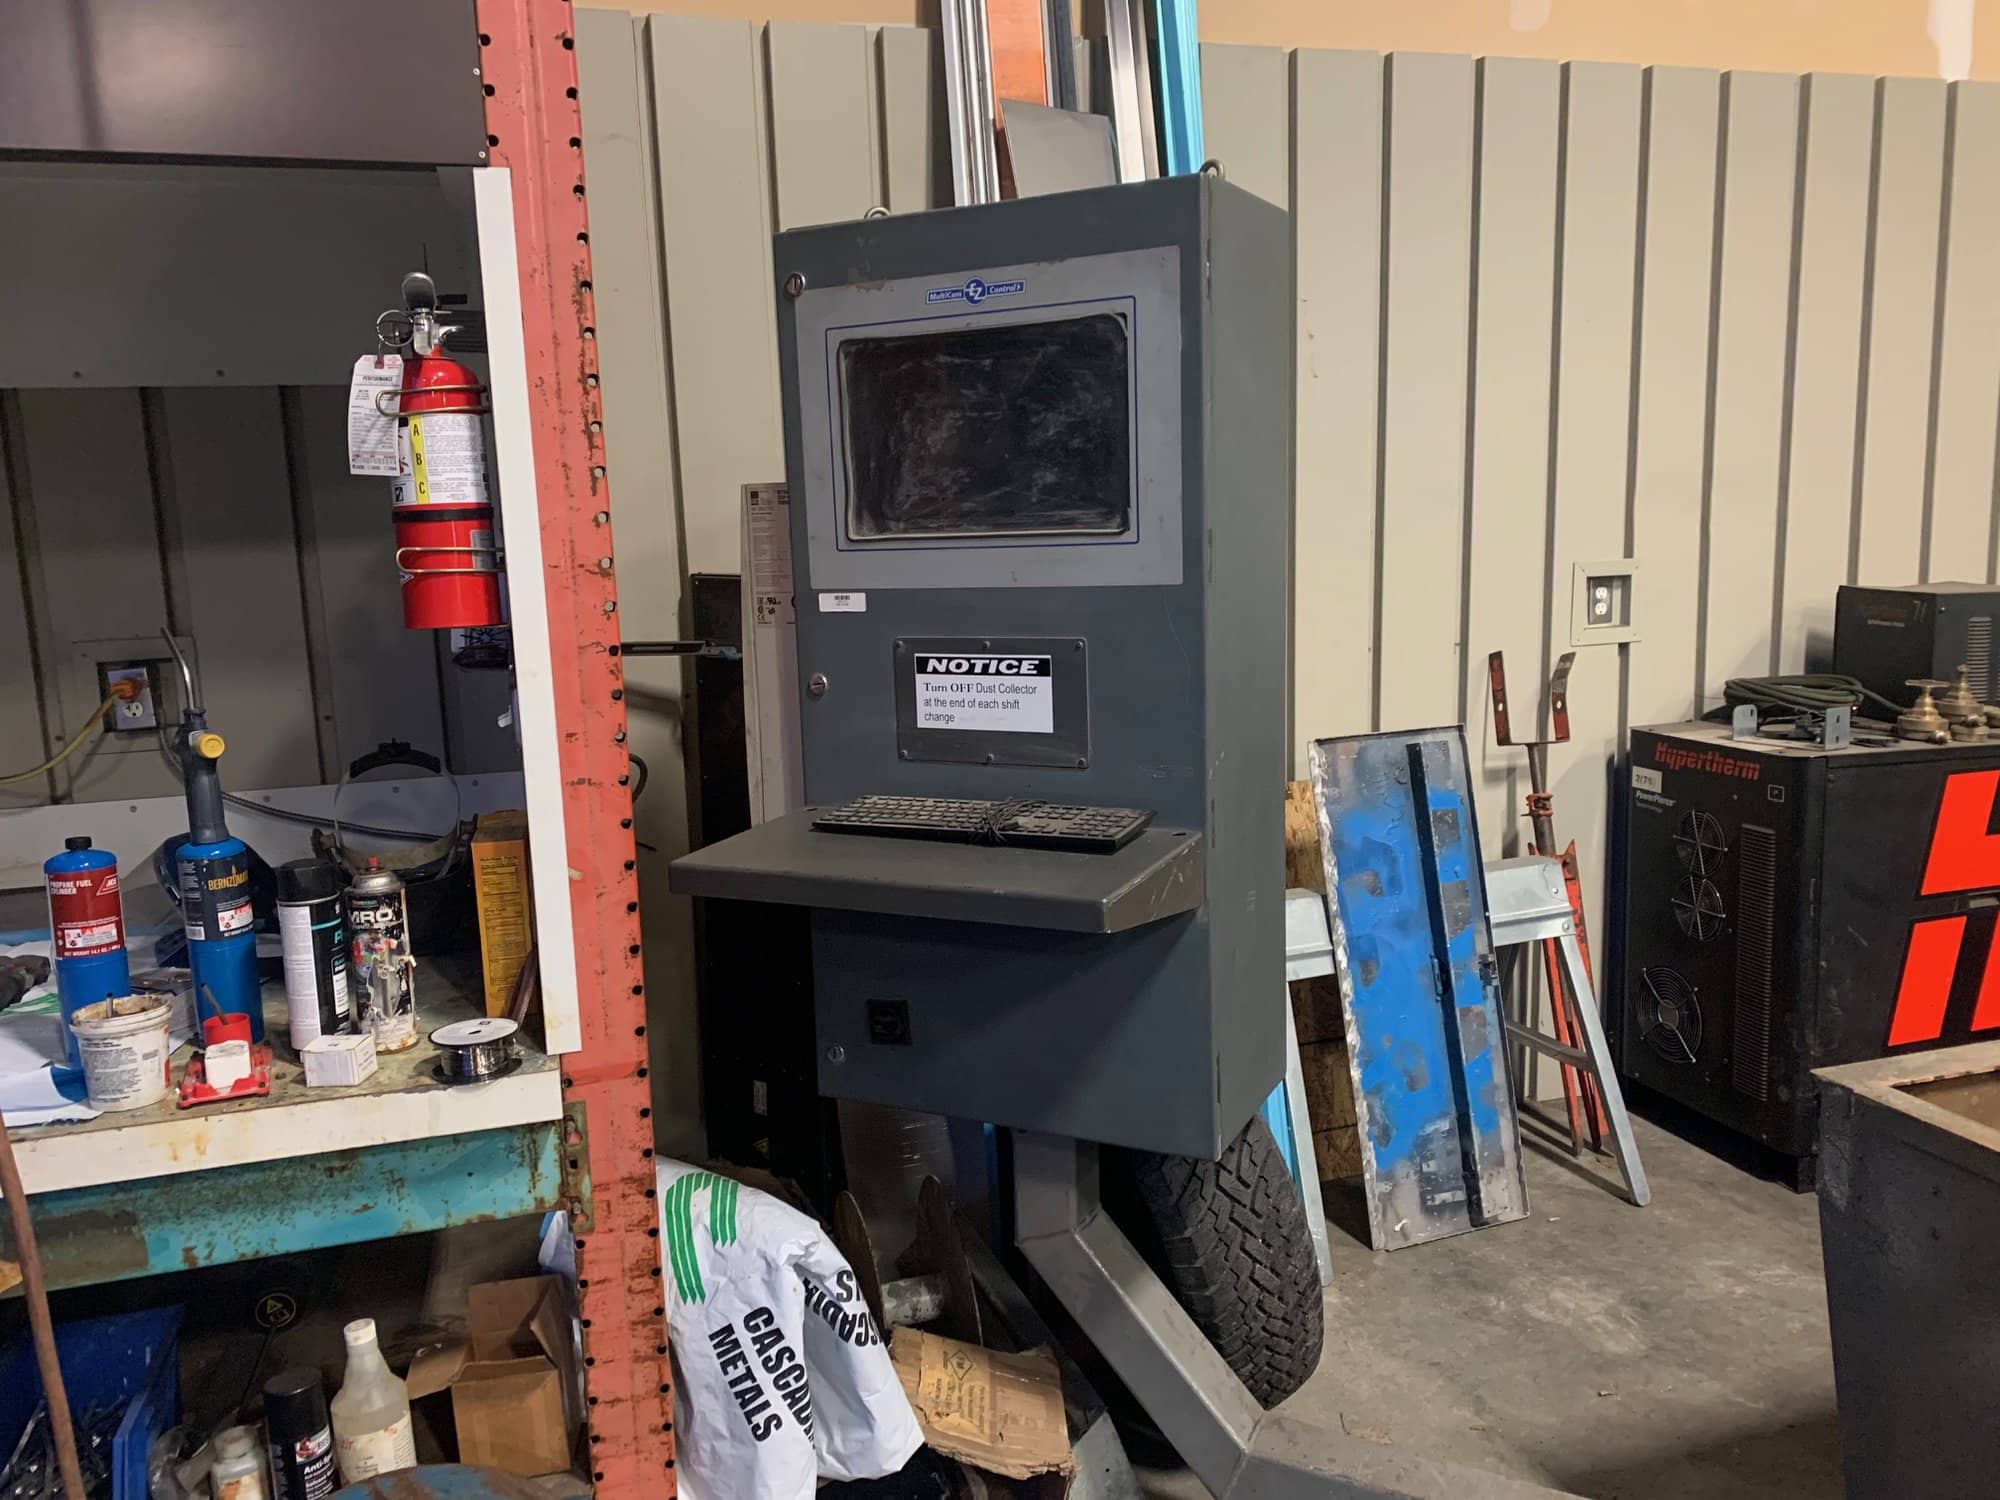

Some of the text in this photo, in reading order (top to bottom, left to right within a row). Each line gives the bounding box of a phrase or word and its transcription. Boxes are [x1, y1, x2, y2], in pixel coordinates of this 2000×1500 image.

[413, 424, 420, 436] A
[415, 453, 422, 465] B
[419, 482, 426, 494] C
[926, 658, 1039, 675] NOTICE
[924, 683, 1038, 695] Turn OFF Dust Collector
[923, 698, 1020, 710] at the end of each shift
[924, 711, 956, 725] change
[1654, 741, 1761, 781] Hypertherm
[76, 880, 93, 888] FUEL
[709, 1323, 783, 1442] METALS
